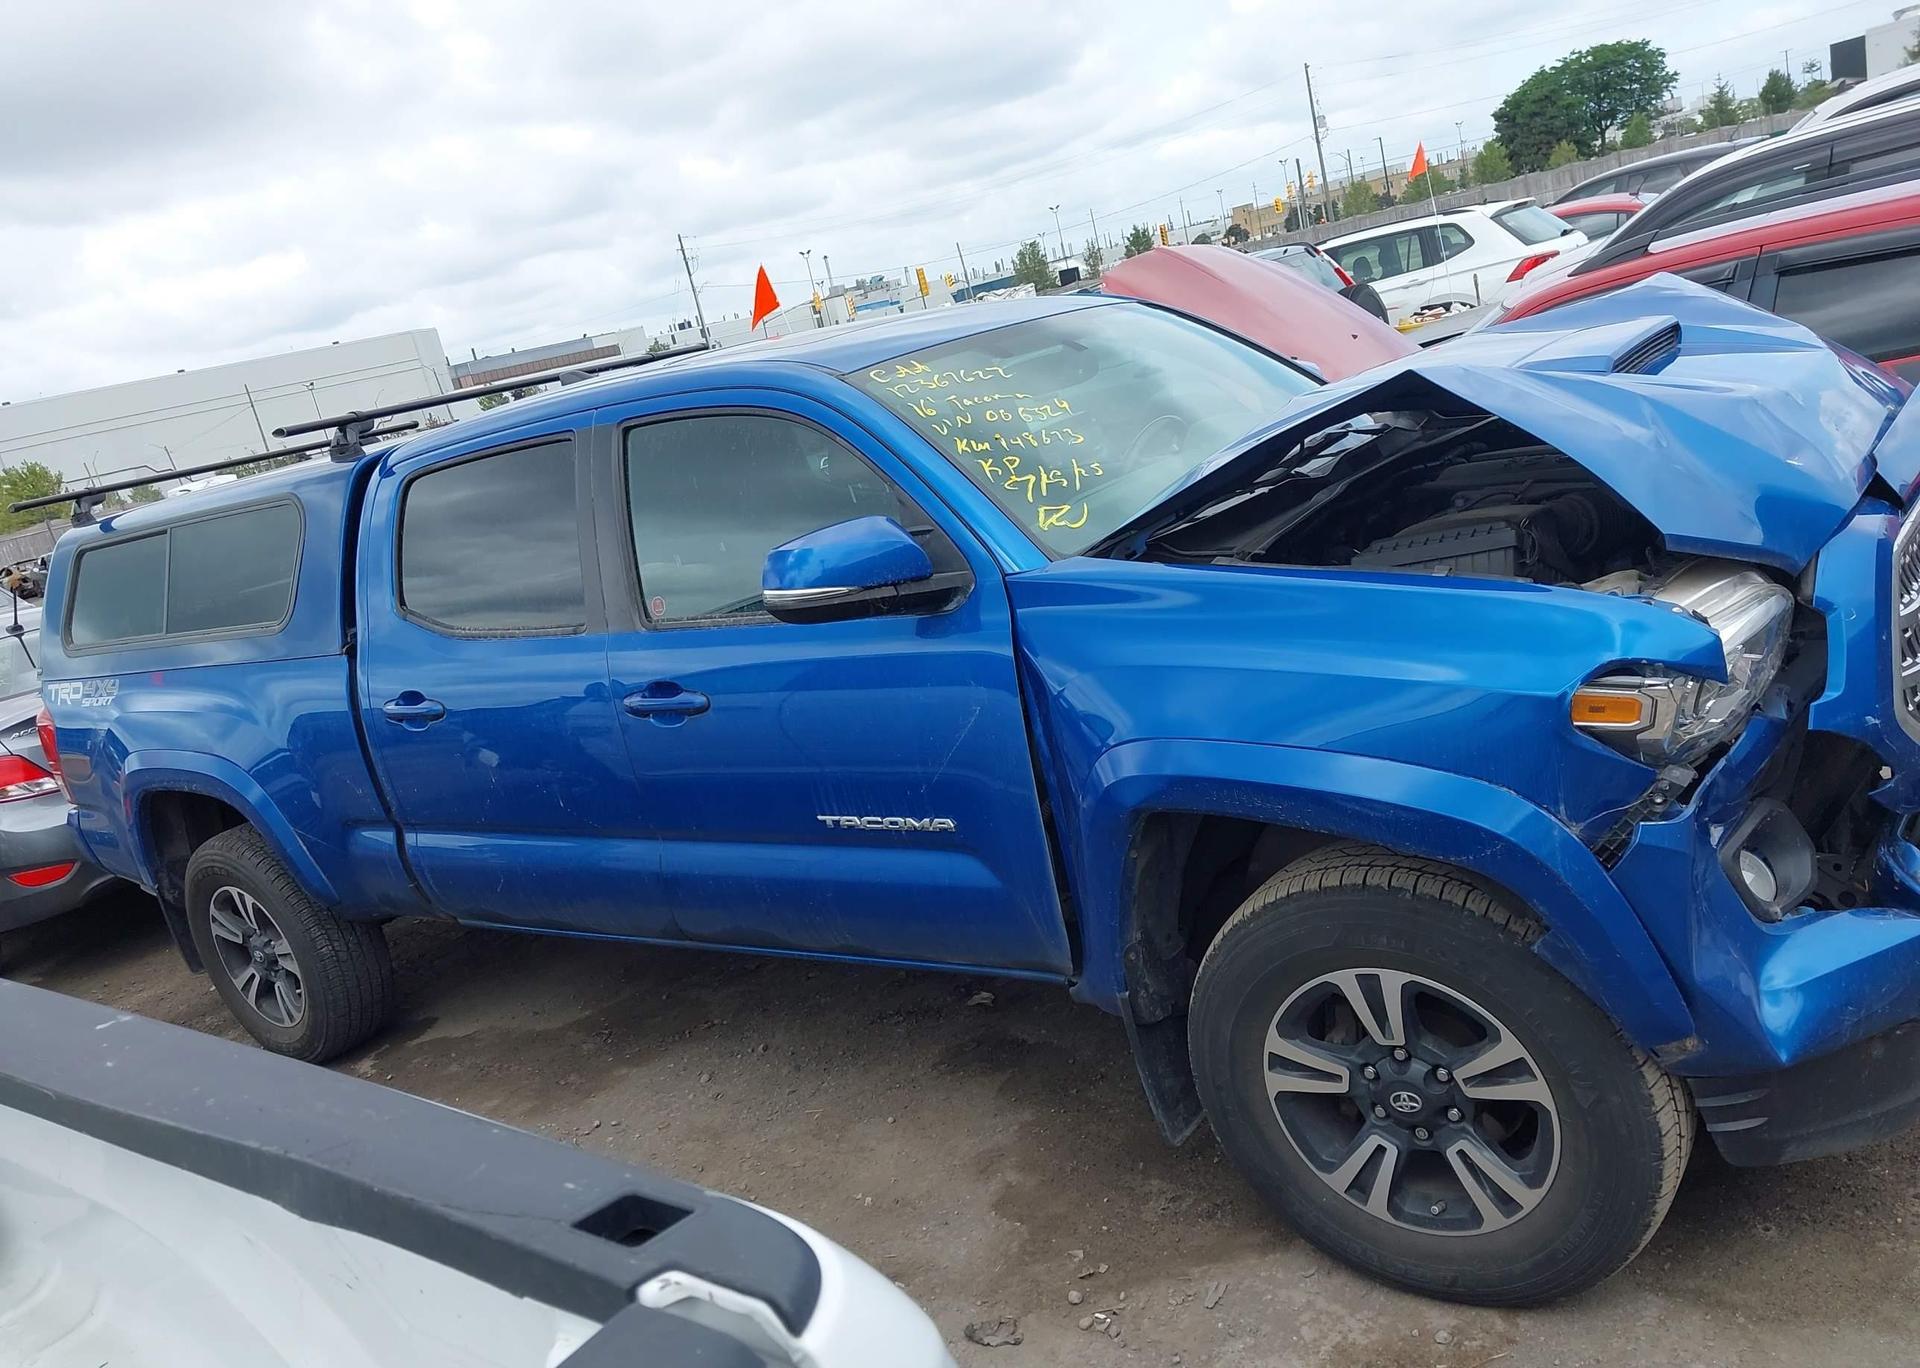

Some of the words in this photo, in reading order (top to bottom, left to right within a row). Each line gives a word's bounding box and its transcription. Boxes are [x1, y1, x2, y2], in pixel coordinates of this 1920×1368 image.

[931, 412, 972, 436] VIN
[47, 681, 83, 706] TRD
[81, 696, 116, 707] SPORT
[816, 815, 957, 832] TACOMA
